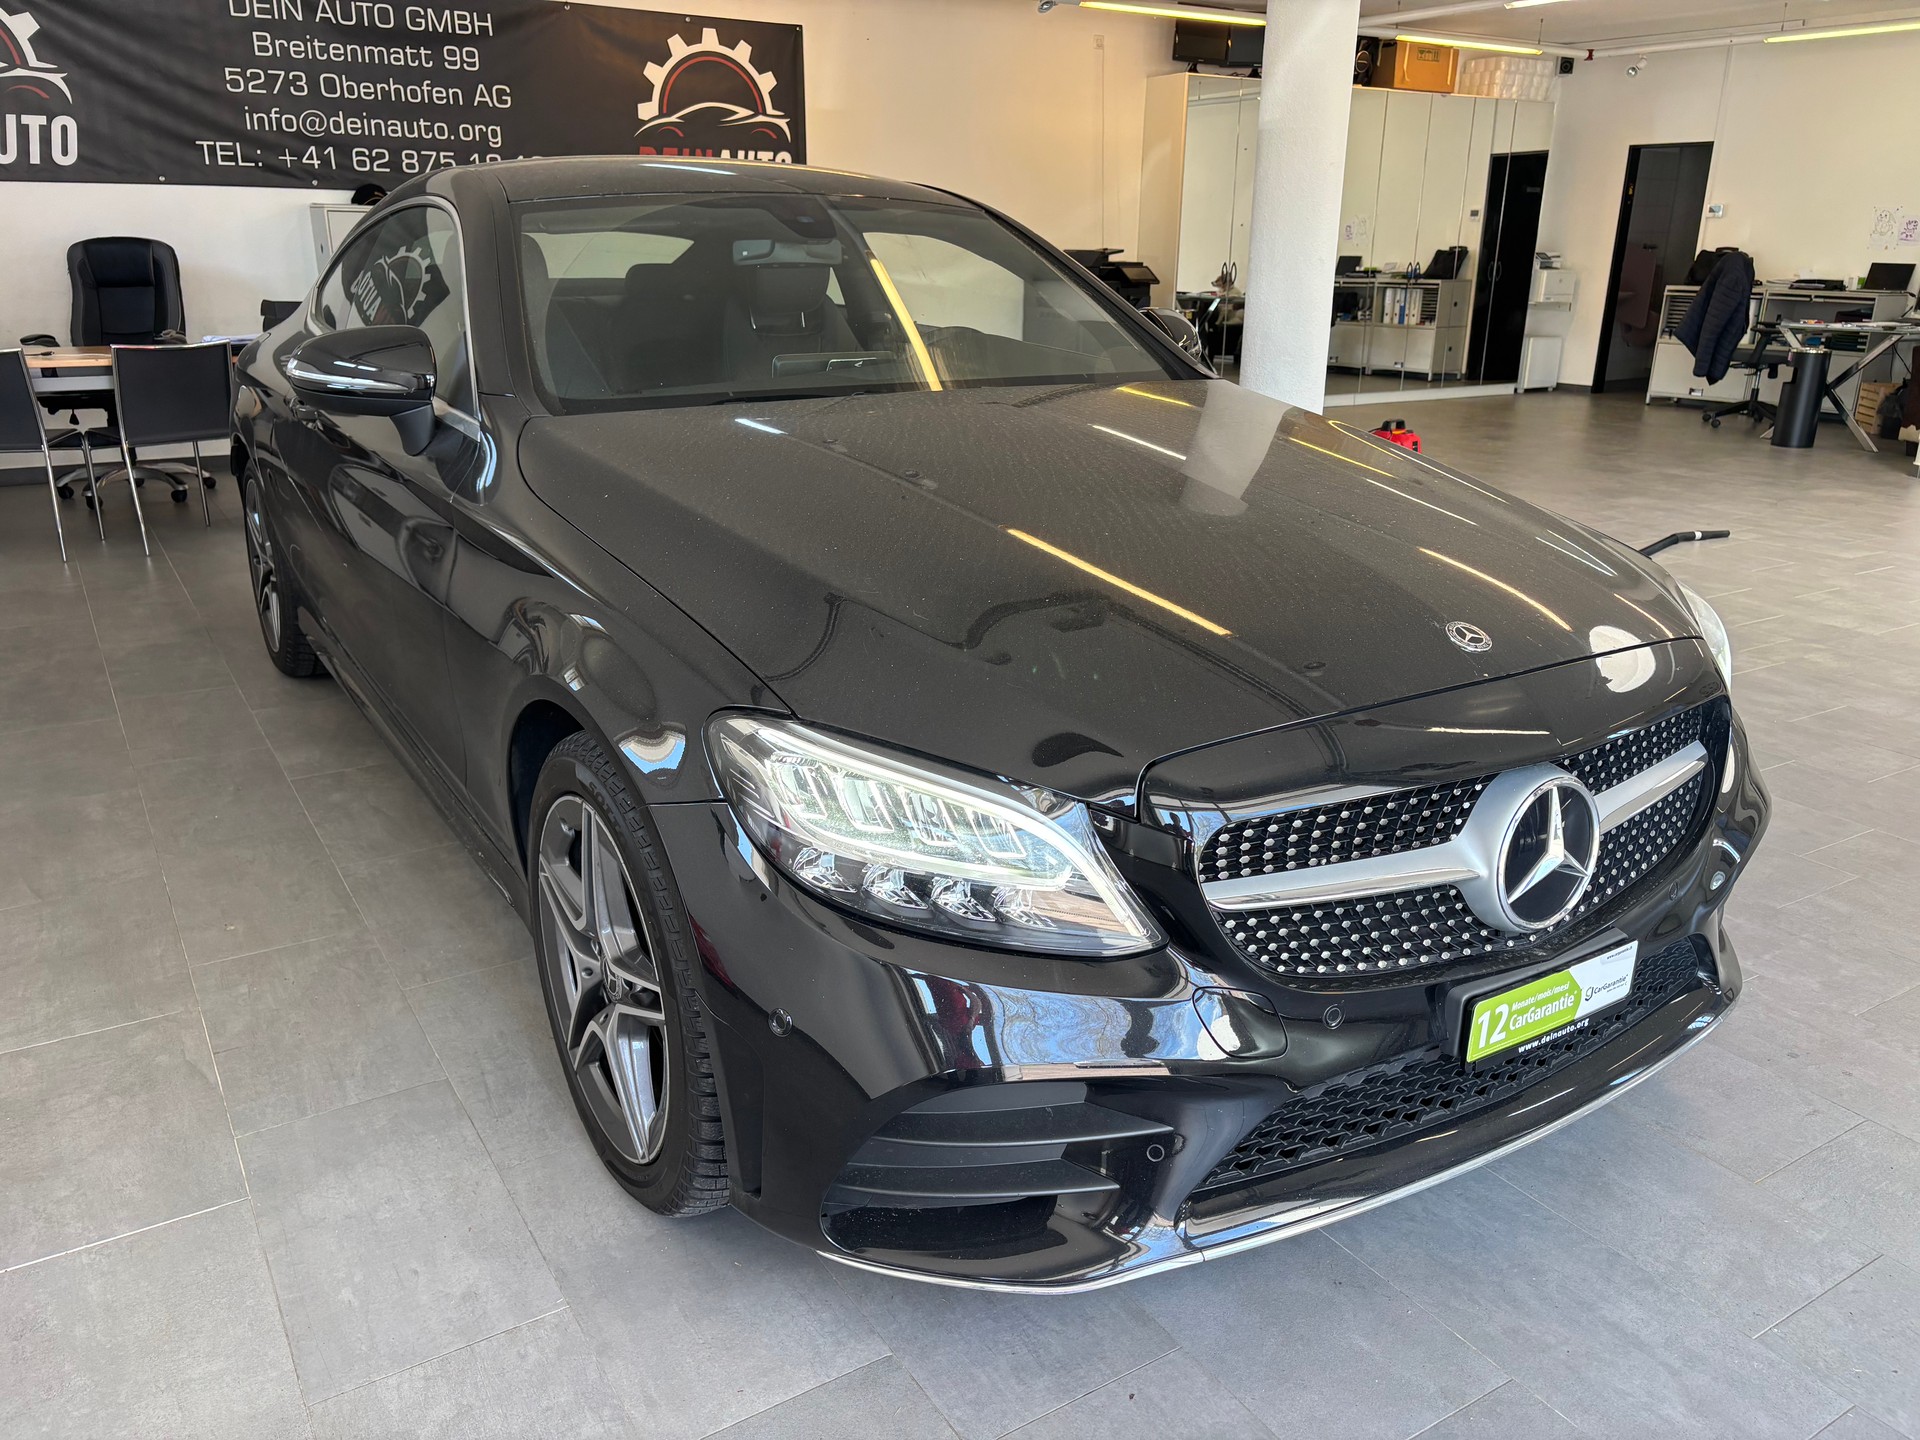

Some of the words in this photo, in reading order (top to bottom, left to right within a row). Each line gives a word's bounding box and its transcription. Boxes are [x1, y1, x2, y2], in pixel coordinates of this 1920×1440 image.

[228, 0, 303, 21] DEIN
[315, 0, 395, 29] AUTO
[405, 6, 494, 37] GMBH
[252, 31, 433, 68] Breitenmatt
[443, 45, 481, 71] 99
[224, 67, 308, 96] 5273
[319, 73, 464, 106] Oberhofen
[473, 83, 512, 109] AG
[244, 105, 502, 148] info@deinauto.org
[195, 140, 263, 167] TEL:
[278, 145, 337, 170] +41
[352, 147, 391, 173] 62
[401, 149, 457, 174] 875
[1477, 1003, 1509, 1049] 12
[1509, 993, 1575, 1031] CarGarantie
[1518, 1018, 1590, 1053] www.deinauto.org
